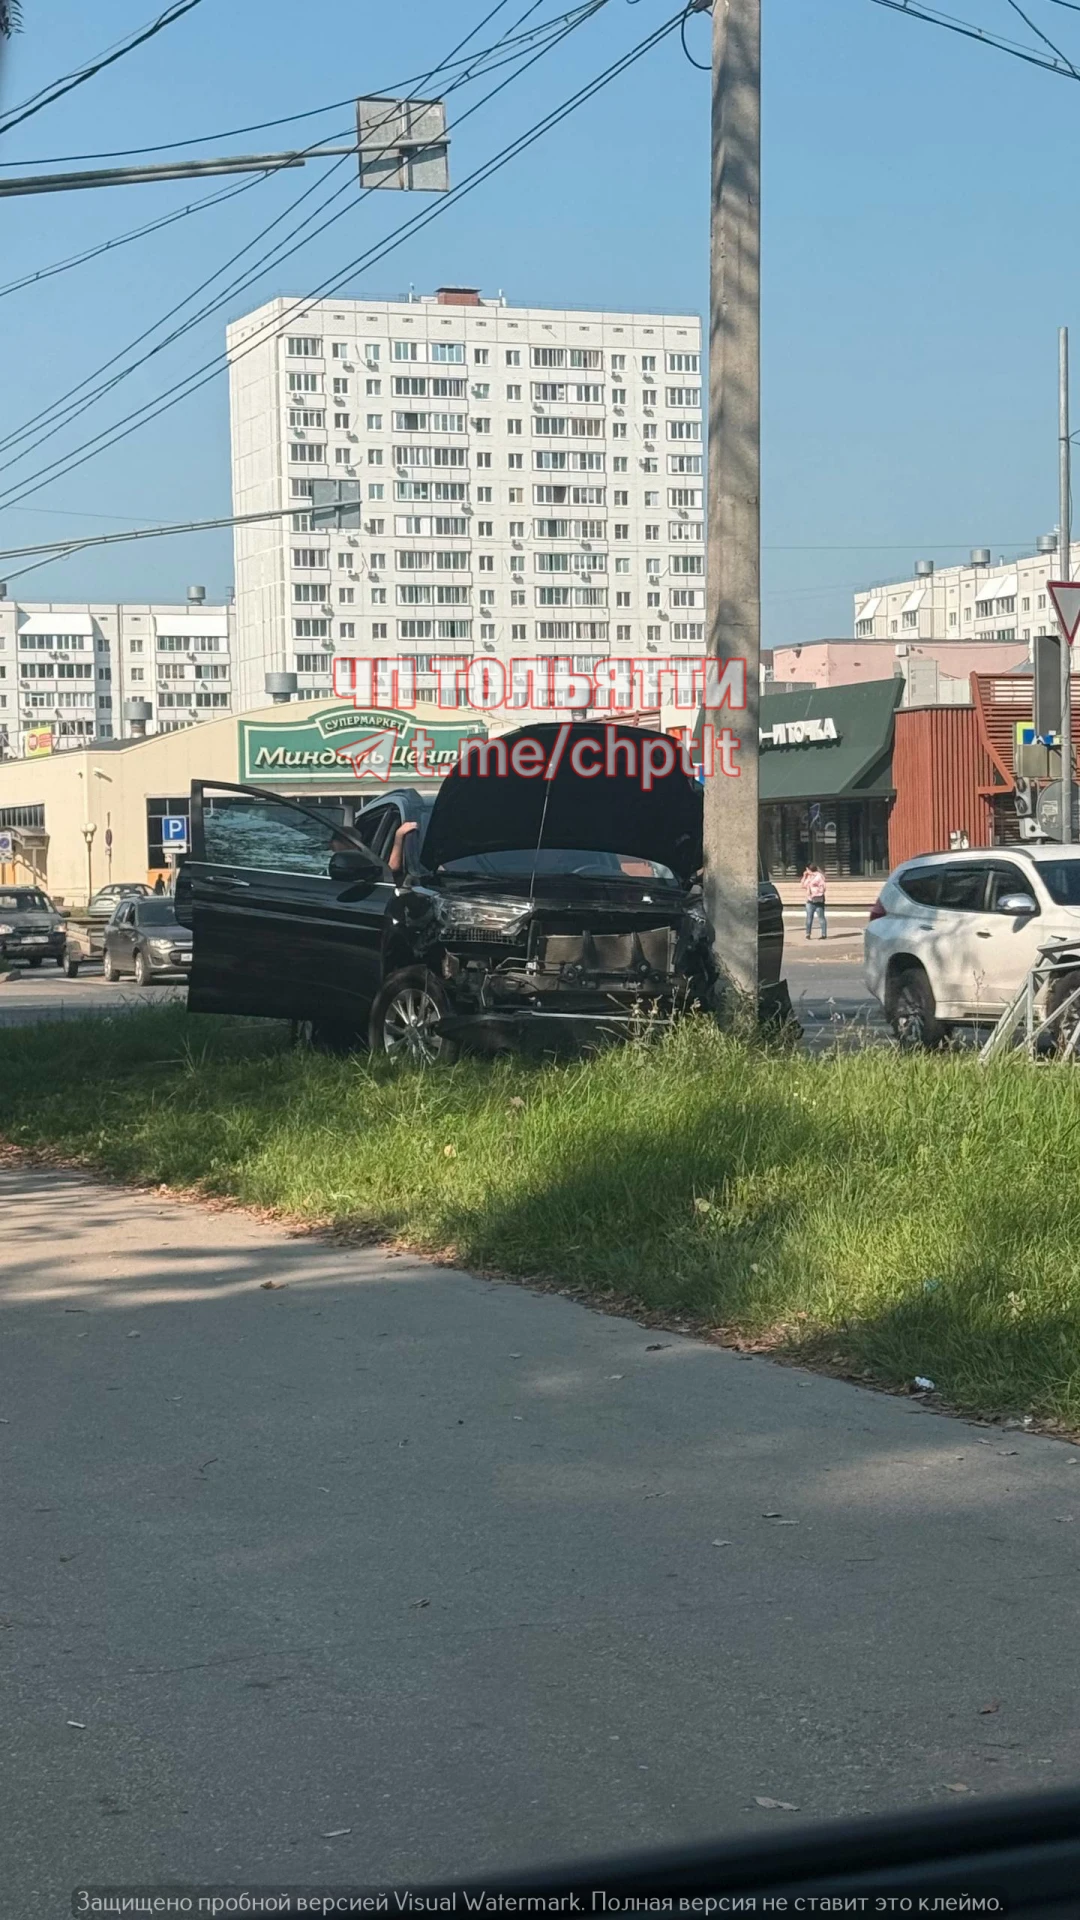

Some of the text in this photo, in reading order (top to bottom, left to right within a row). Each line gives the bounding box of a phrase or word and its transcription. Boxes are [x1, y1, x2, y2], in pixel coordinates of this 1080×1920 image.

[323, 715, 405, 731] СУПЕРМАРКЕТ
[254, 745, 463, 767] Миндаль Цент
[168, 819, 183, 839] P
